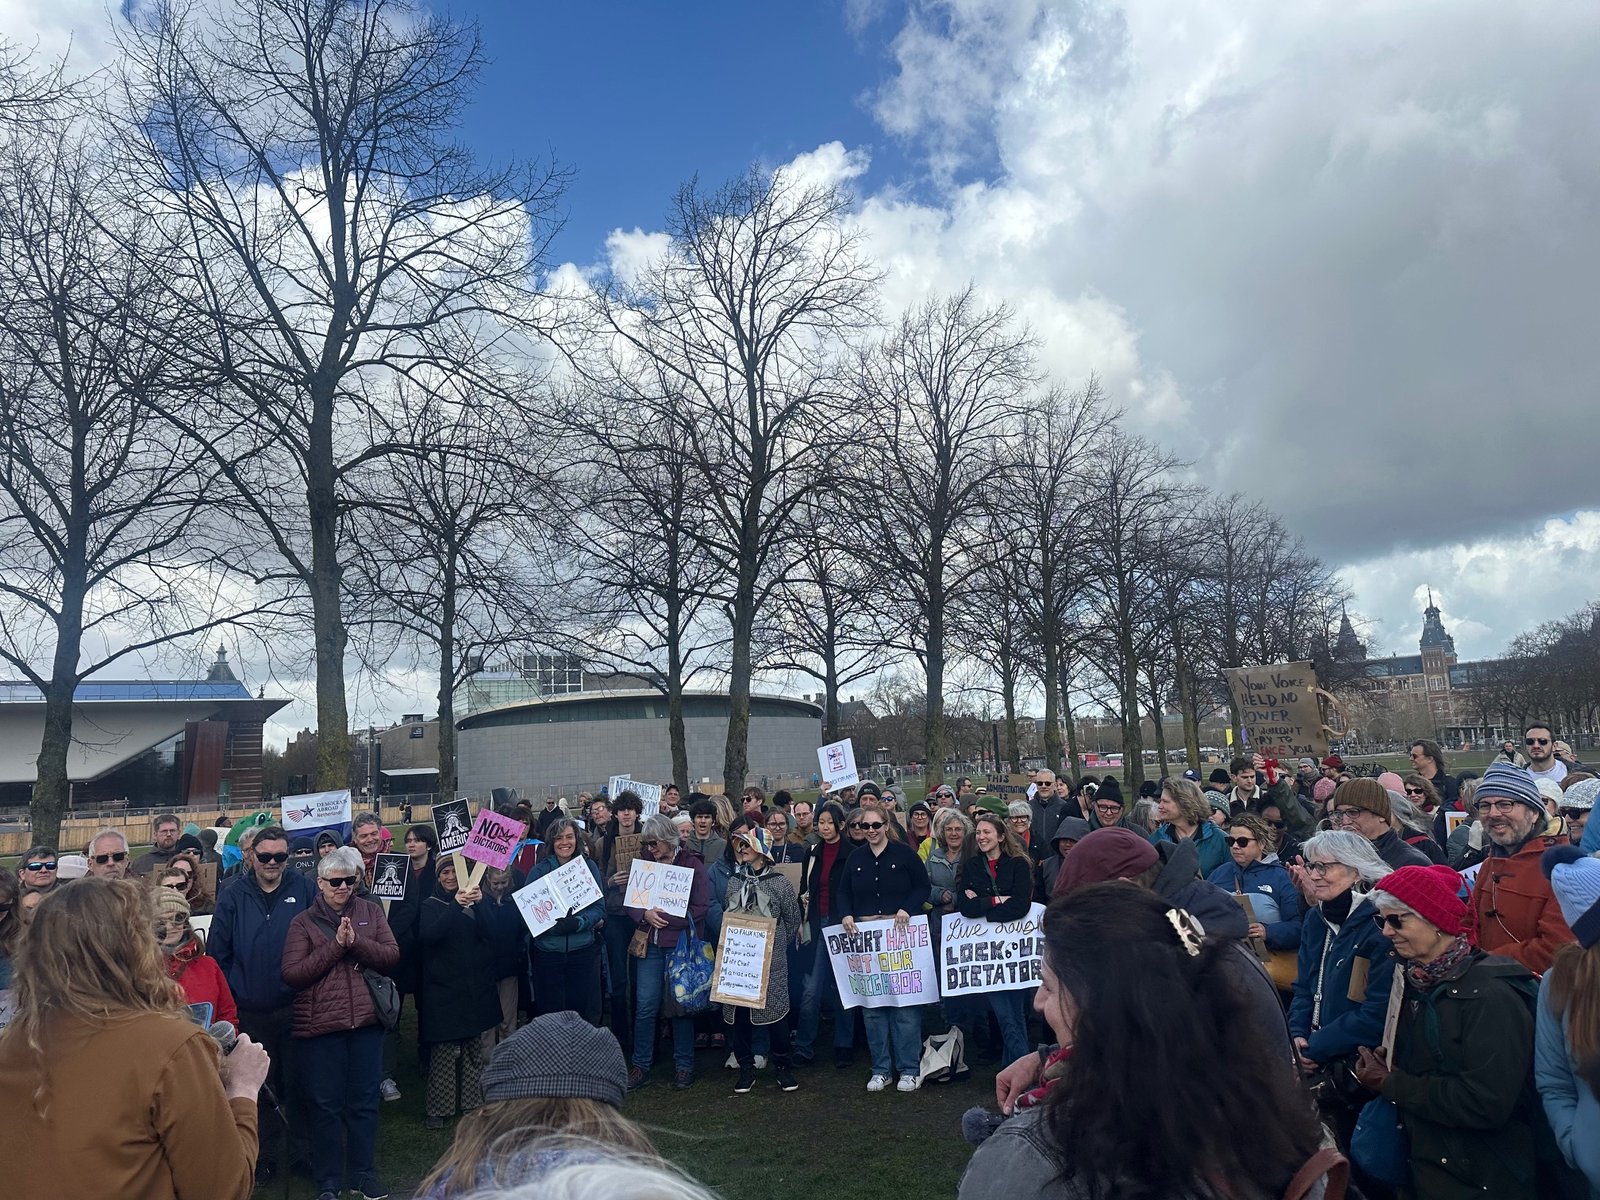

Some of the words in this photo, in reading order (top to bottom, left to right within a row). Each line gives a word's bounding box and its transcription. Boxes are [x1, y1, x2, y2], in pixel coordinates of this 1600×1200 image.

[1241, 693, 1277, 707] HELD
[1281, 692, 1298, 703] NO
[1242, 709, 1292, 722] POWER
[1288, 745, 1314, 756] YOU
[986, 774, 1009, 783] THIS
[478, 818, 500, 840] NO
[441, 833, 469, 850] AMERIC
[473, 836, 508, 855] DICTATORS
[295, 861, 315, 869] ONLY
[665, 870, 691, 881] FAUX
[373, 885, 403, 896] AMERICA
[663, 883, 689, 893] KING
[946, 918, 989, 942] Live
[828, 930, 883, 955] DEPORT
[886, 923, 929, 951] HATE
[878, 949, 914, 972] OUR
[946, 941, 1005, 966] LOCK
[848, 970, 923, 996] NEIGHBOR
